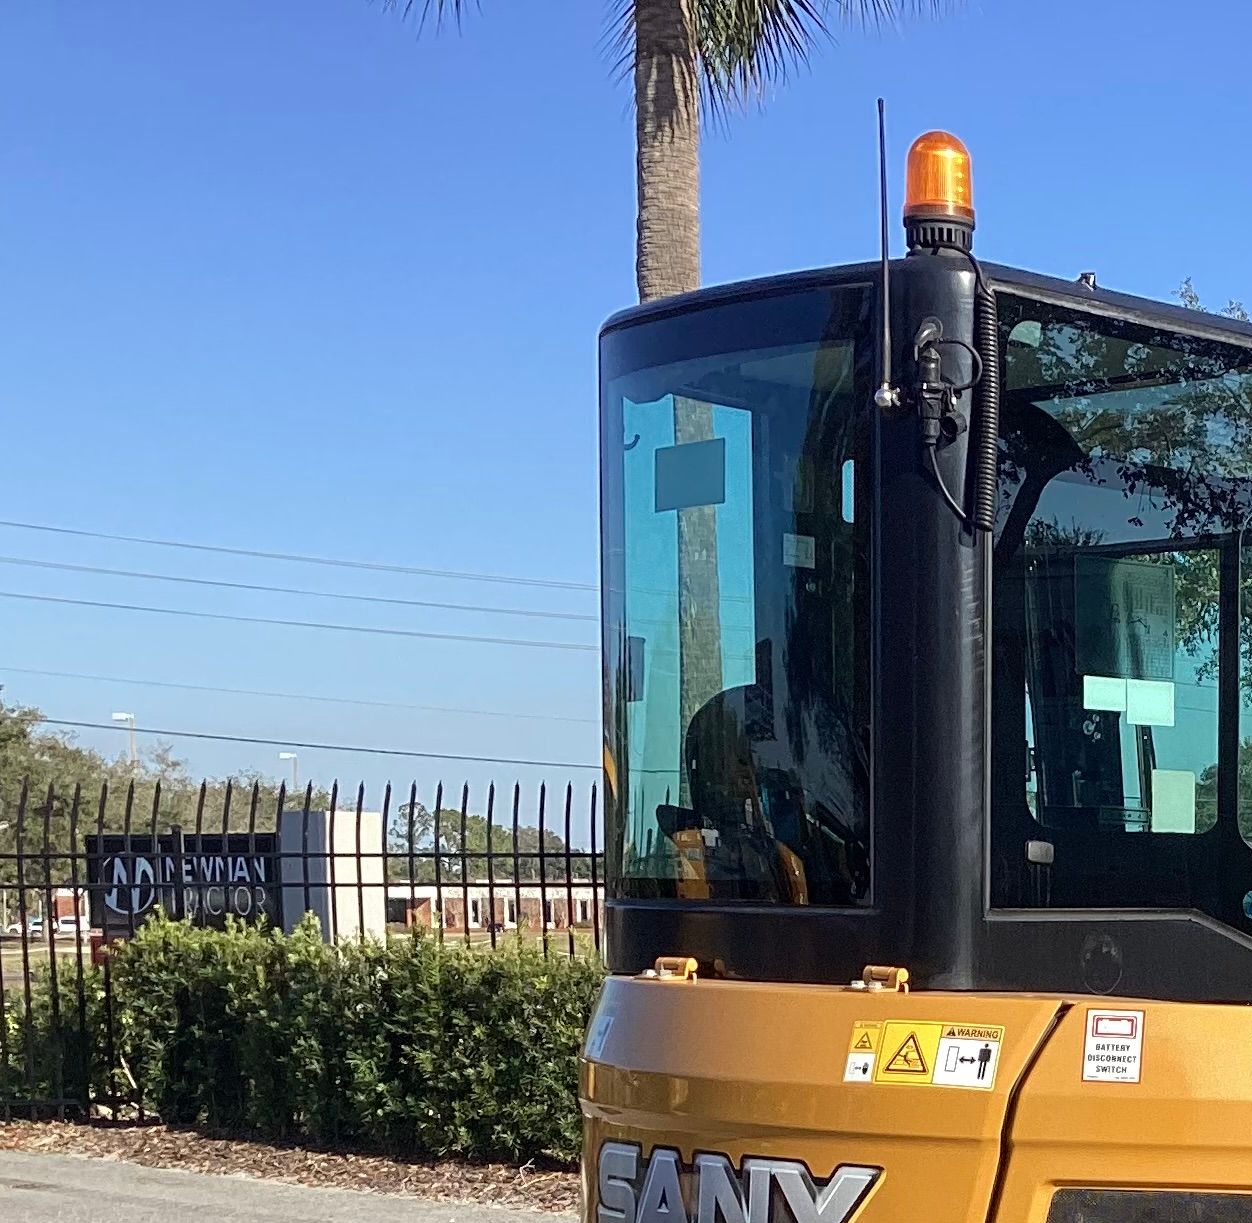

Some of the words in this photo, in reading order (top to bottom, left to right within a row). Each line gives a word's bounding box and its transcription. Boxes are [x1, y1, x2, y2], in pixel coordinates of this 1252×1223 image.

[957, 1028, 999, 1039] WARNING
[1095, 1043, 1131, 1052] BATTERY
[1087, 1054, 1137, 1063] DISCONNECT
[1095, 1065, 1127, 1073] SWITCH
